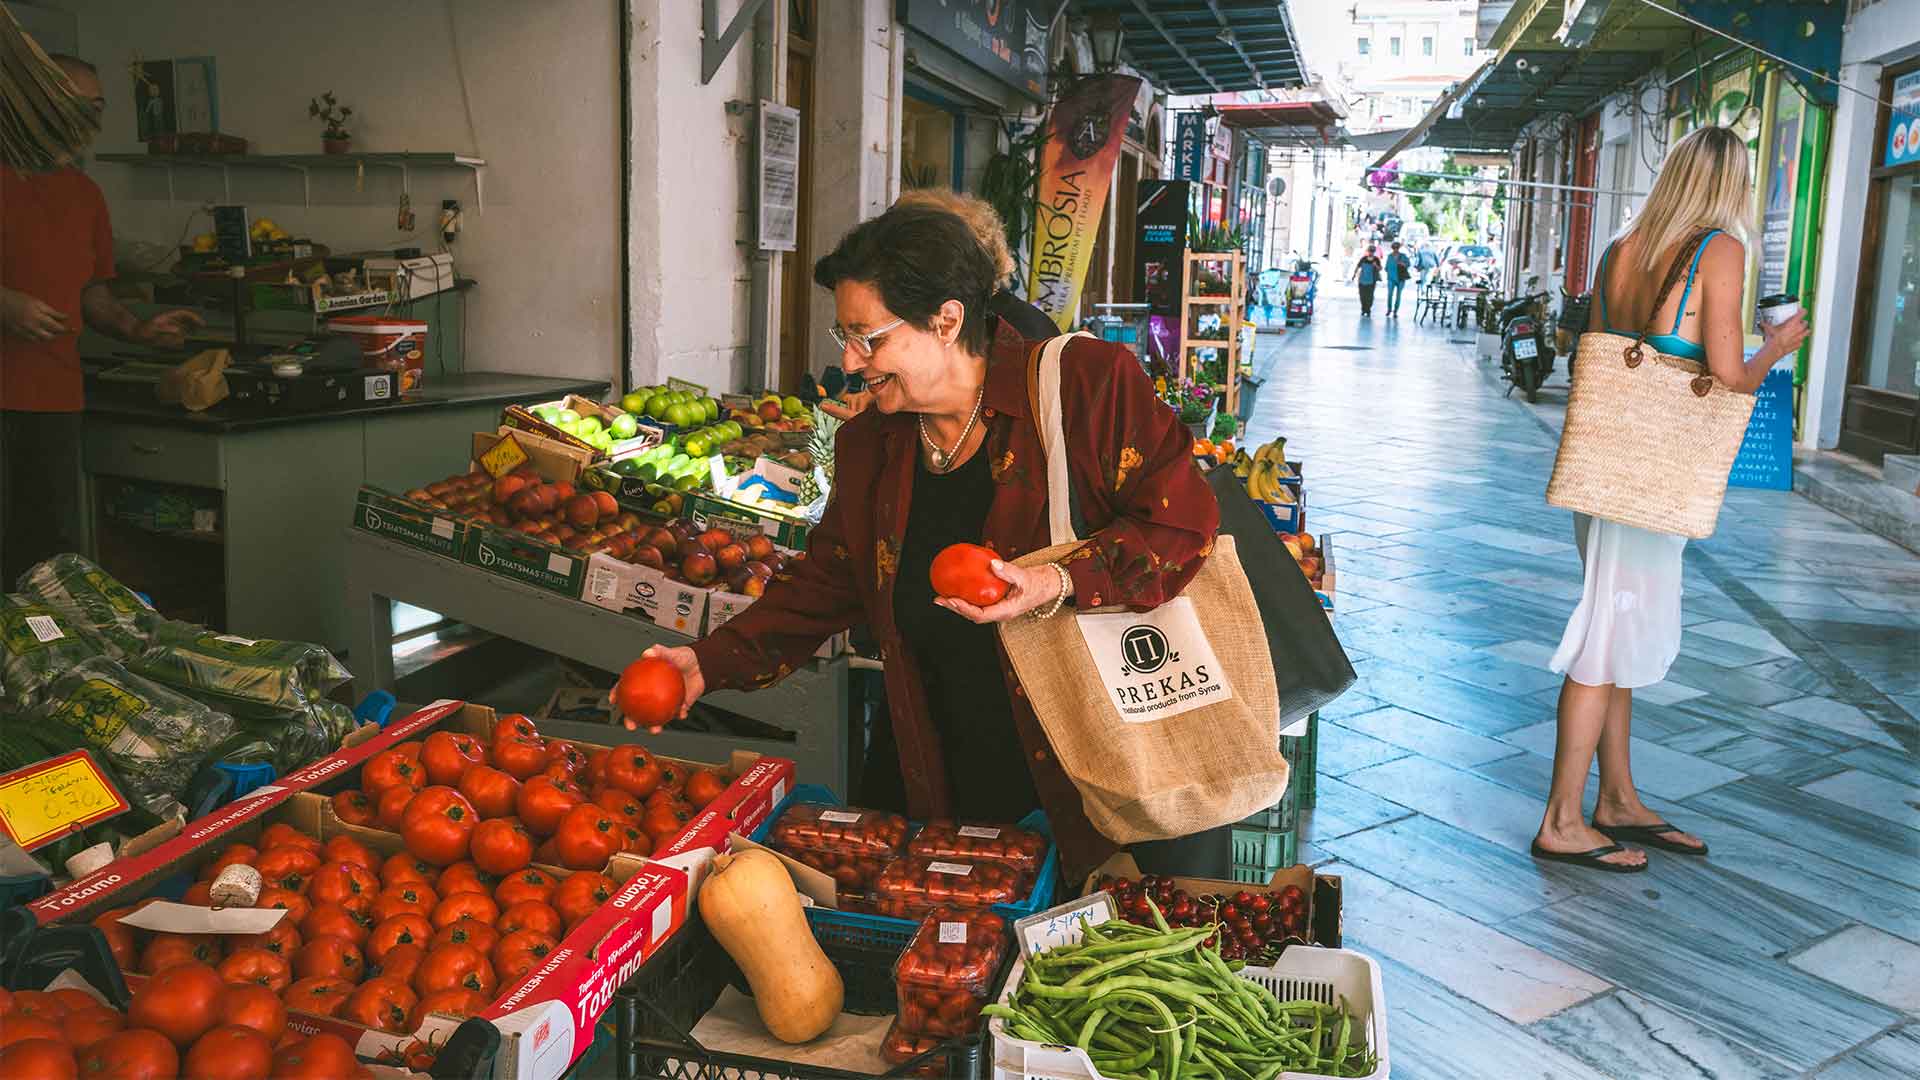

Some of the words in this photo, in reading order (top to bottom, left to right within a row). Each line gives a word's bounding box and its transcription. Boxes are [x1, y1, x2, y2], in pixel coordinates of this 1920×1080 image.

[1181, 114, 1198, 181] MARKE
[1036, 169, 1087, 312] MBROSIA
[1062, 238, 1082, 284] PREMIUM
[359, 293, 386, 306] Garden
[1116, 664, 1210, 705] PREKAS
[1146, 696, 1178, 713] products
[1178, 691, 1198, 703] from
[1197, 682, 1221, 698] Syros
[294, 758, 349, 784] Totamo
[40, 874, 122, 912] Totamo
[612, 872, 663, 908] Totamo
[577, 950, 642, 1029] Totamo
